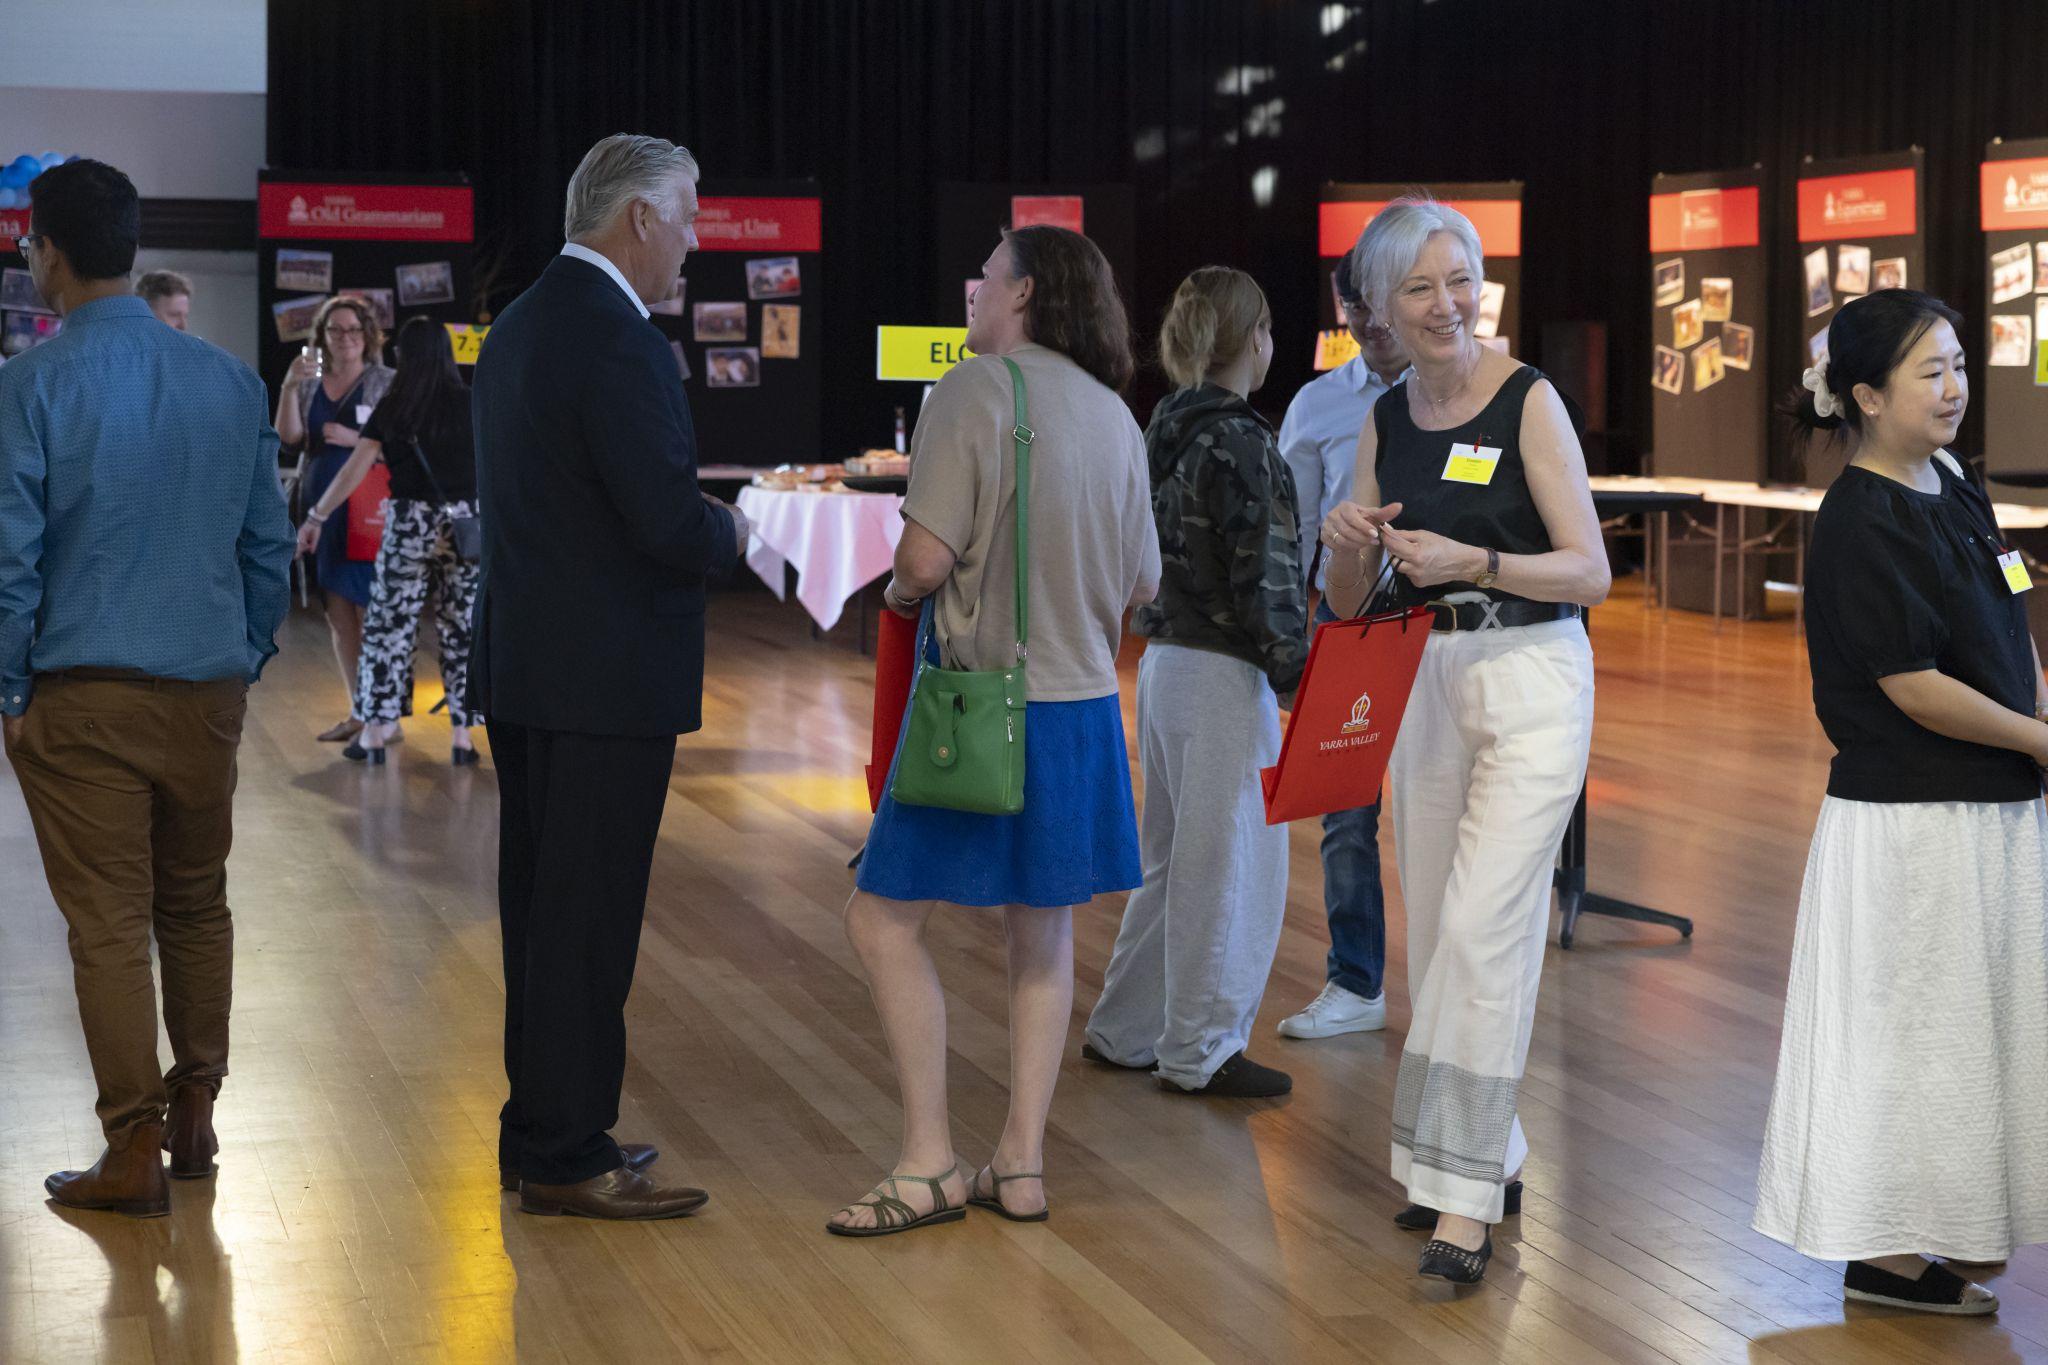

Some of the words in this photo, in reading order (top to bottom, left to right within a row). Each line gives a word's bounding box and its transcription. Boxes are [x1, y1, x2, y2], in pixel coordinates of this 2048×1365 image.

[310, 205, 341, 222] Old
[1320, 739, 1348, 751] YARRA
[1351, 731, 1381, 746] VALLEY
